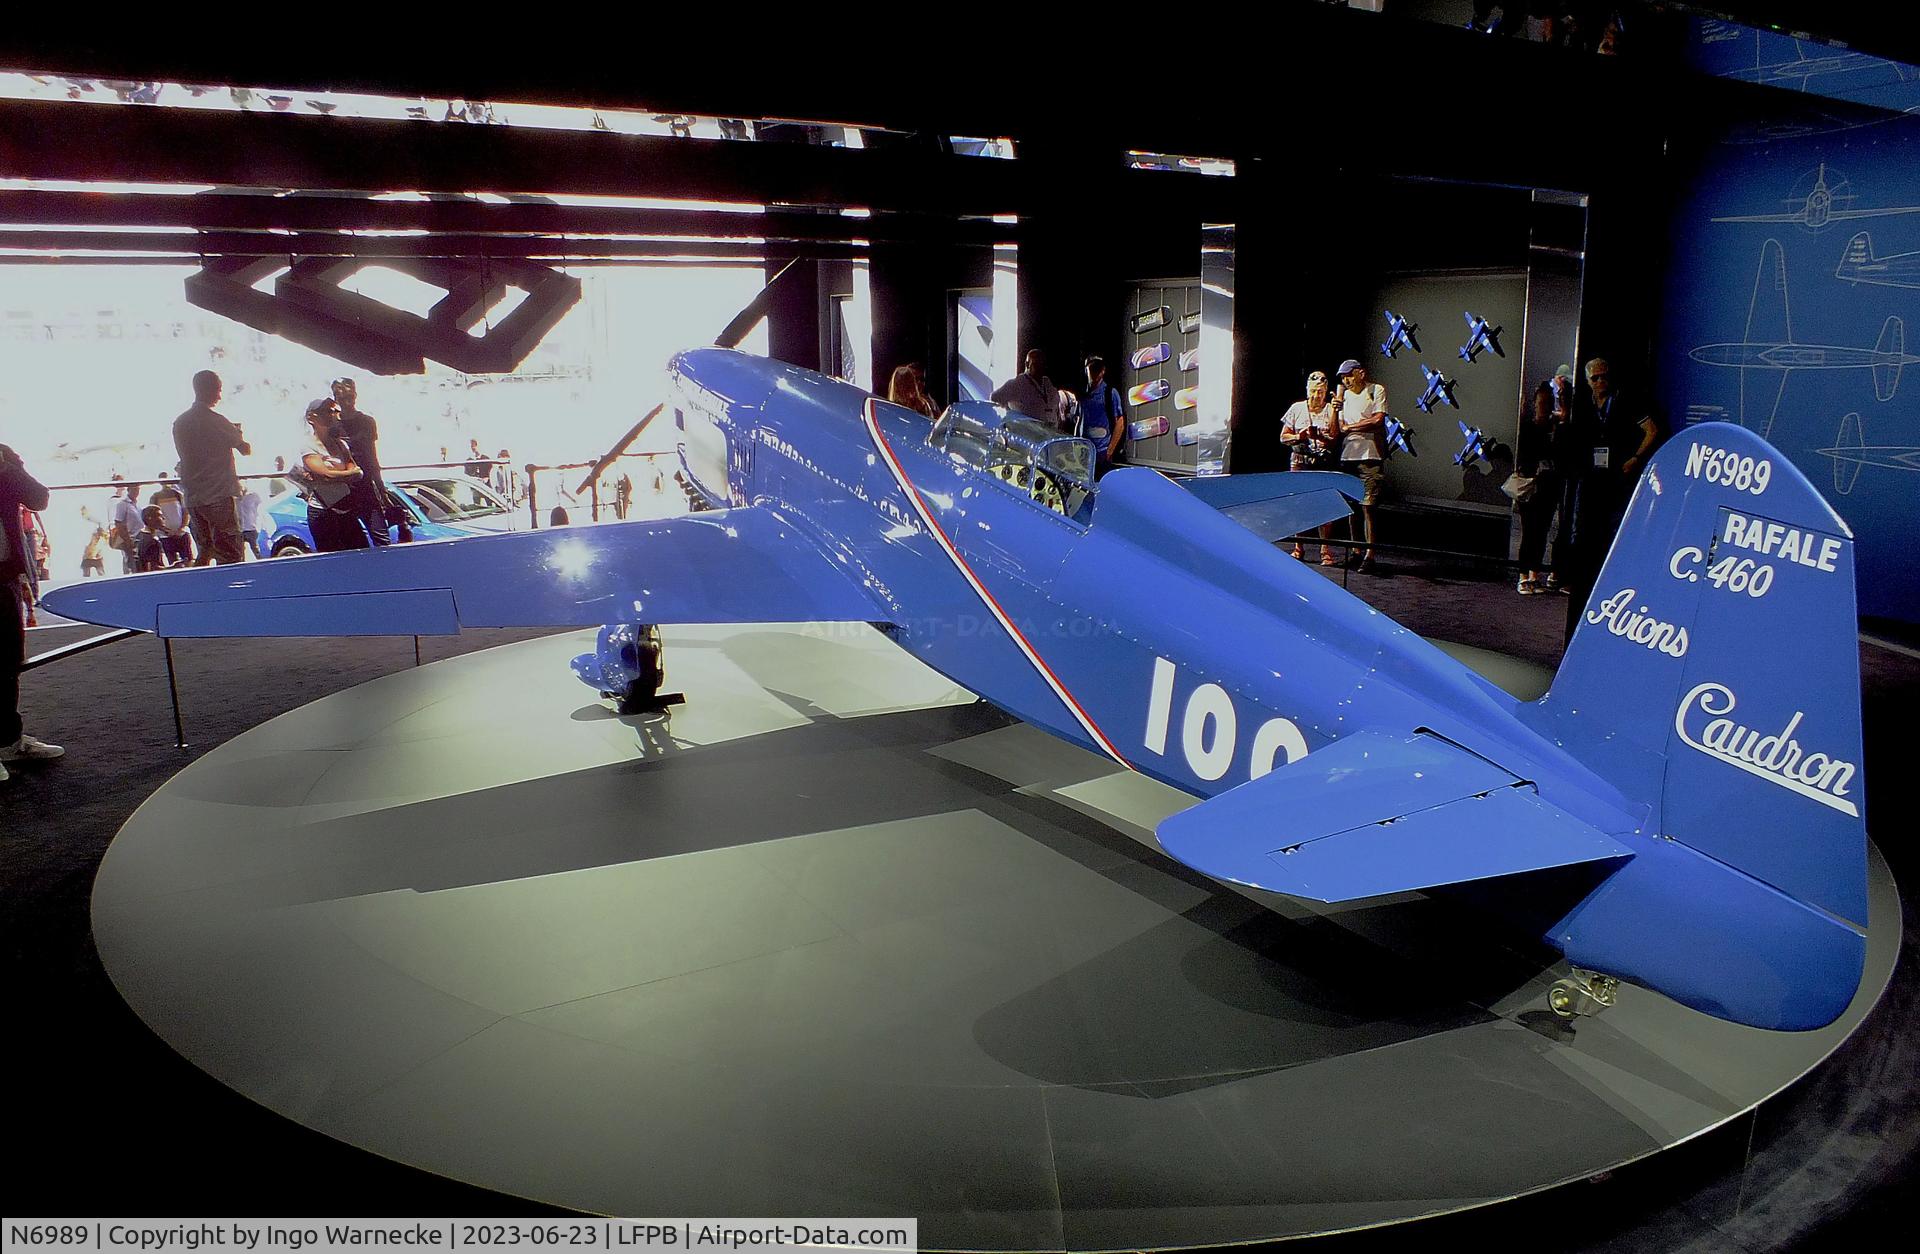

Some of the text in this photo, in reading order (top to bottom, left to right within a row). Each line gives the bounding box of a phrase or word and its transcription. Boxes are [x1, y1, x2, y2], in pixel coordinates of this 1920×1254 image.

[1723, 513, 1841, 573] RAFALE
[1586, 588, 1689, 658] Avions
[1675, 682, 1859, 818] Caudron
